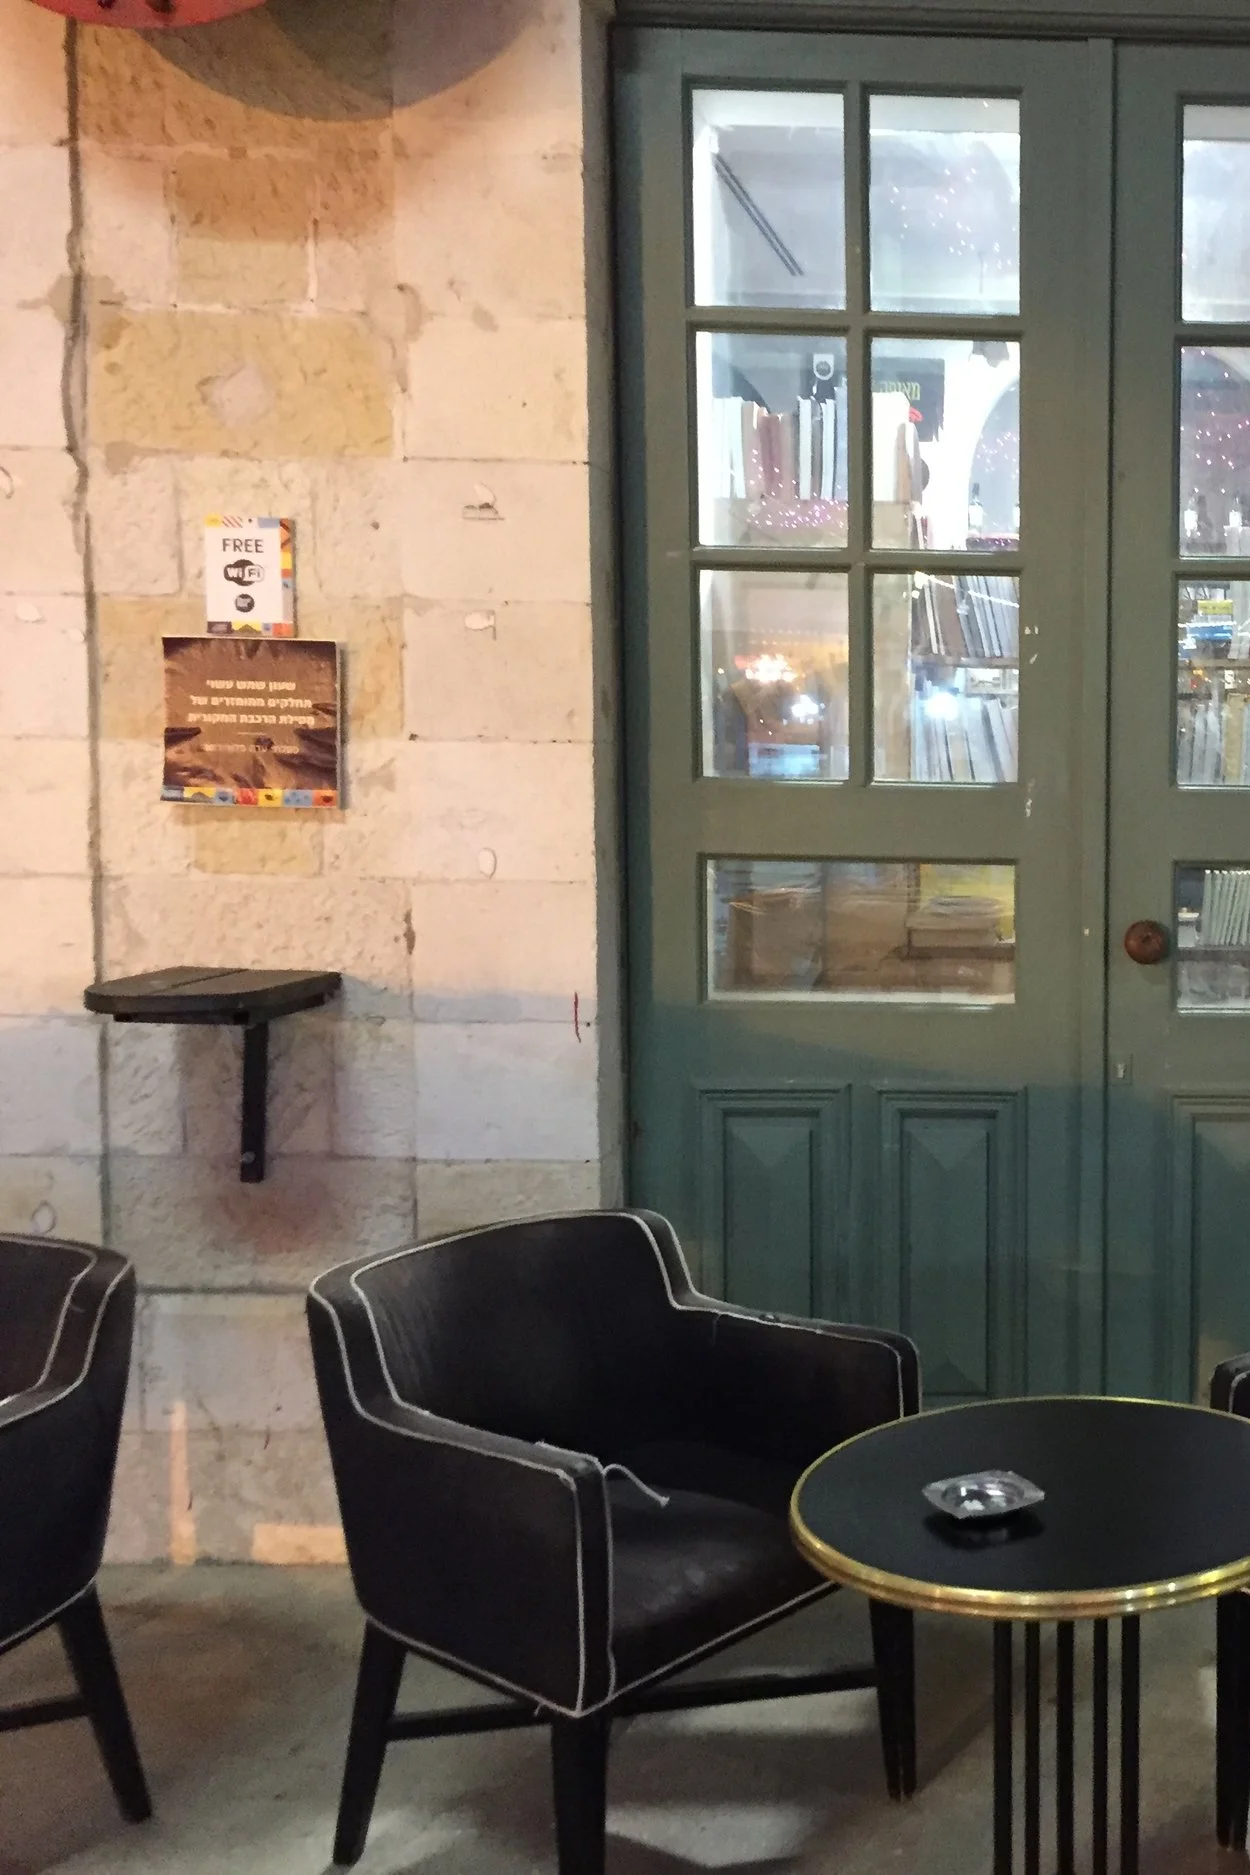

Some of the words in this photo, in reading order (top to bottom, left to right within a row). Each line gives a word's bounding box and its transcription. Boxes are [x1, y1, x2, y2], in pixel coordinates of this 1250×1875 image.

[222, 538, 264, 553] FREE
[236, 680, 266, 690] שמש
[268, 681, 296, 692] שעון
[190, 694, 208, 706] של
[239, 713, 276, 724] הרכבת
